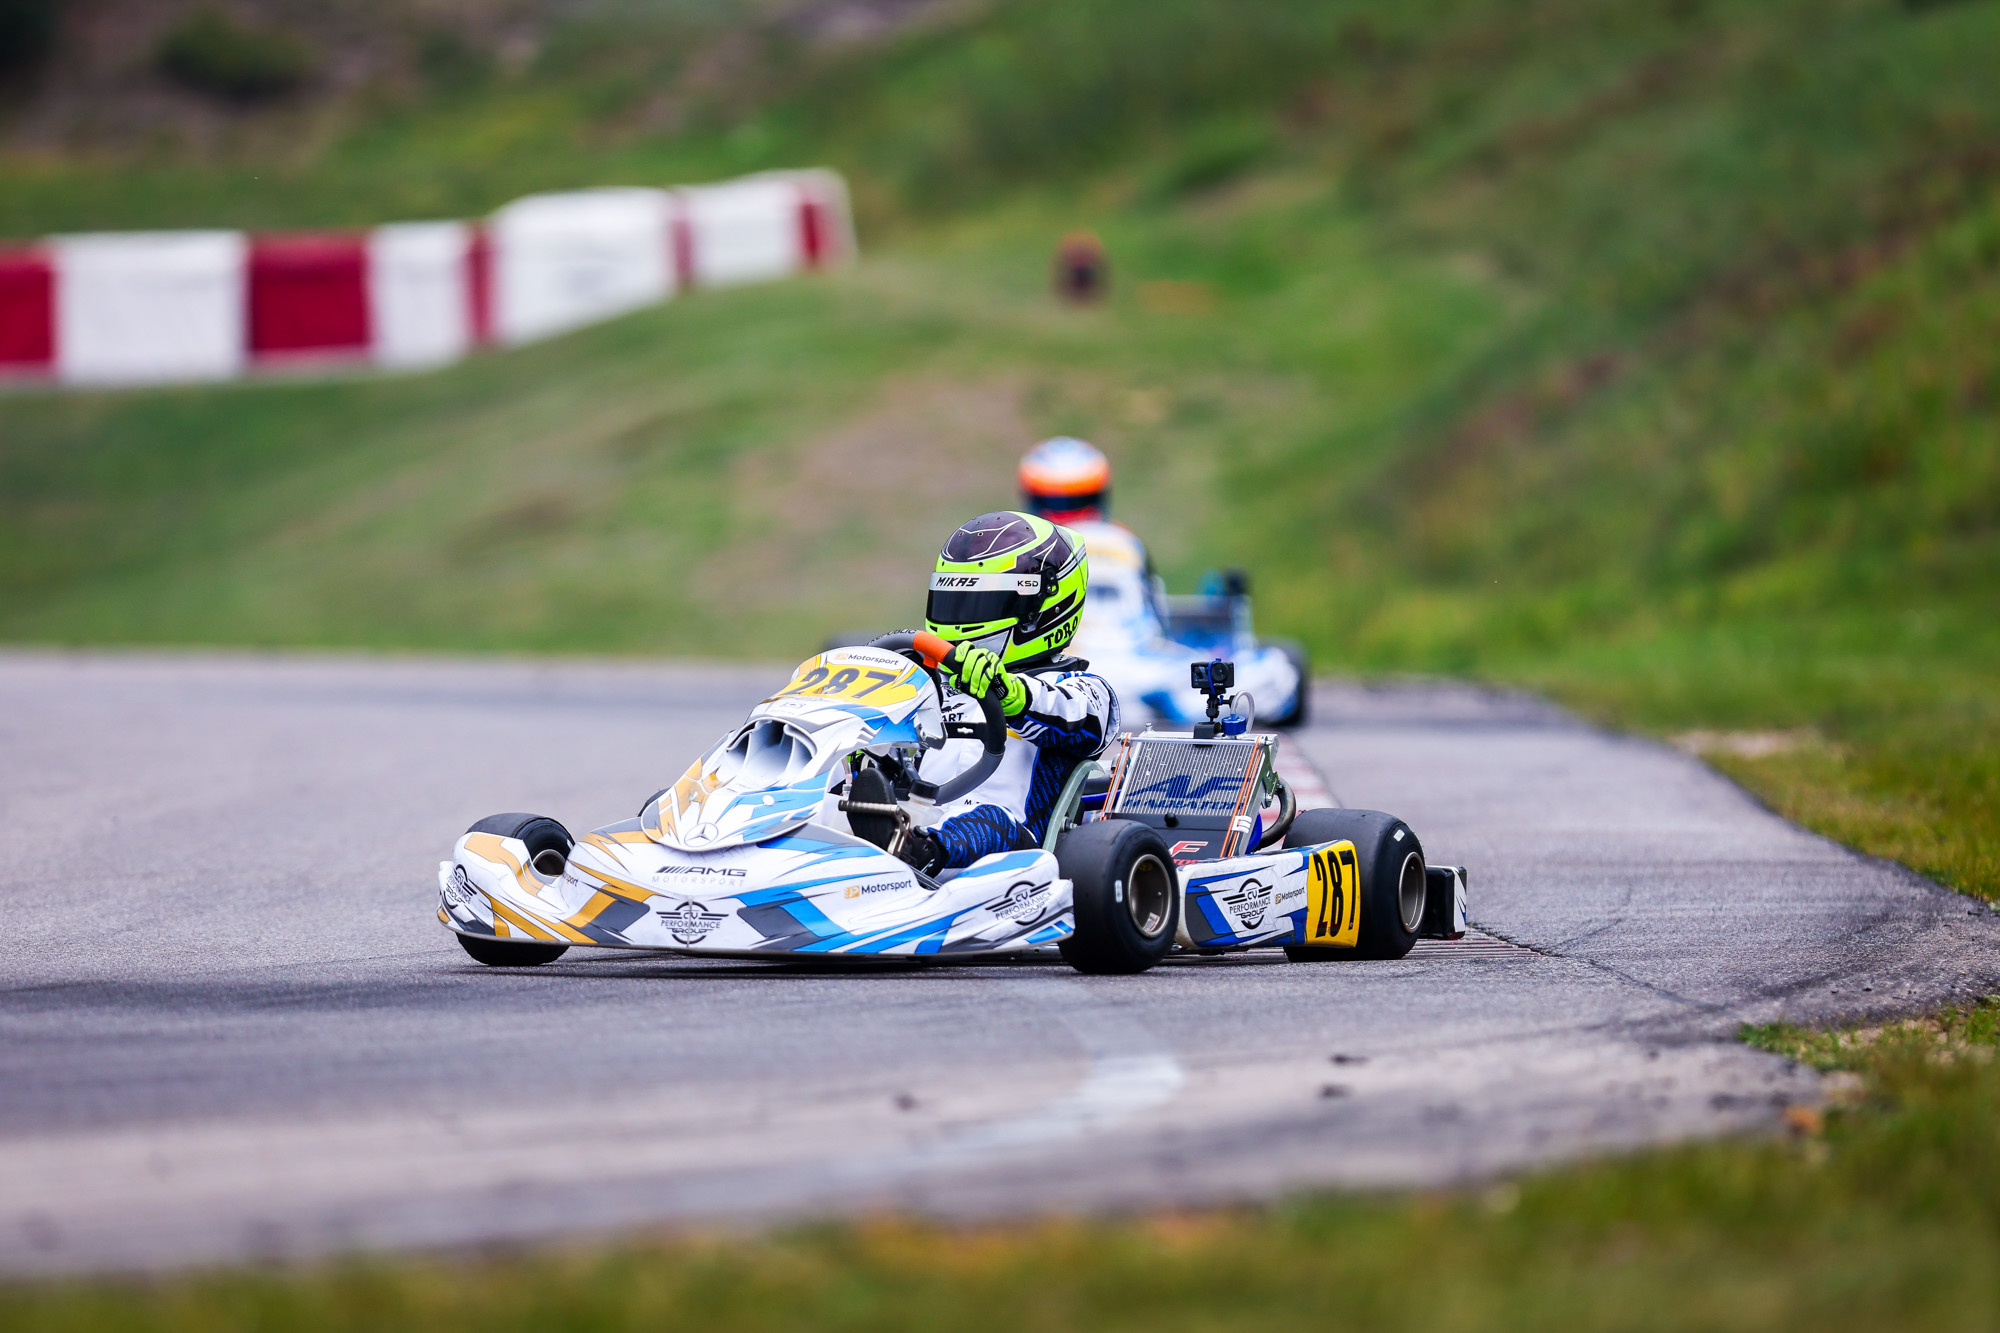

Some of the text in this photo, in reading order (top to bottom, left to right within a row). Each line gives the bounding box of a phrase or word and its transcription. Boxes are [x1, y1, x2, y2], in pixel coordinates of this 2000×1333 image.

[936, 577, 979, 587] MIKAS
[1043, 616, 1079, 649] TORO
[848, 654, 899, 666] Motorsport
[781, 667, 897, 698] 287
[684, 866, 748, 877] AMG
[652, 875, 745, 887] MOTORSPORT
[861, 879, 912, 894] Motorsport
[1016, 891, 1028, 902] CV
[1247, 889, 1258, 900] CV
[1281, 886, 1305, 901] Motorsport
[1312, 849, 1356, 938] 287
[1229, 896, 1271, 914] PERFORMANCE
[683, 911, 699, 920] CV
[1241, 909, 1265, 919] GROUP
[660, 919, 721, 929] PERFORMANCE
